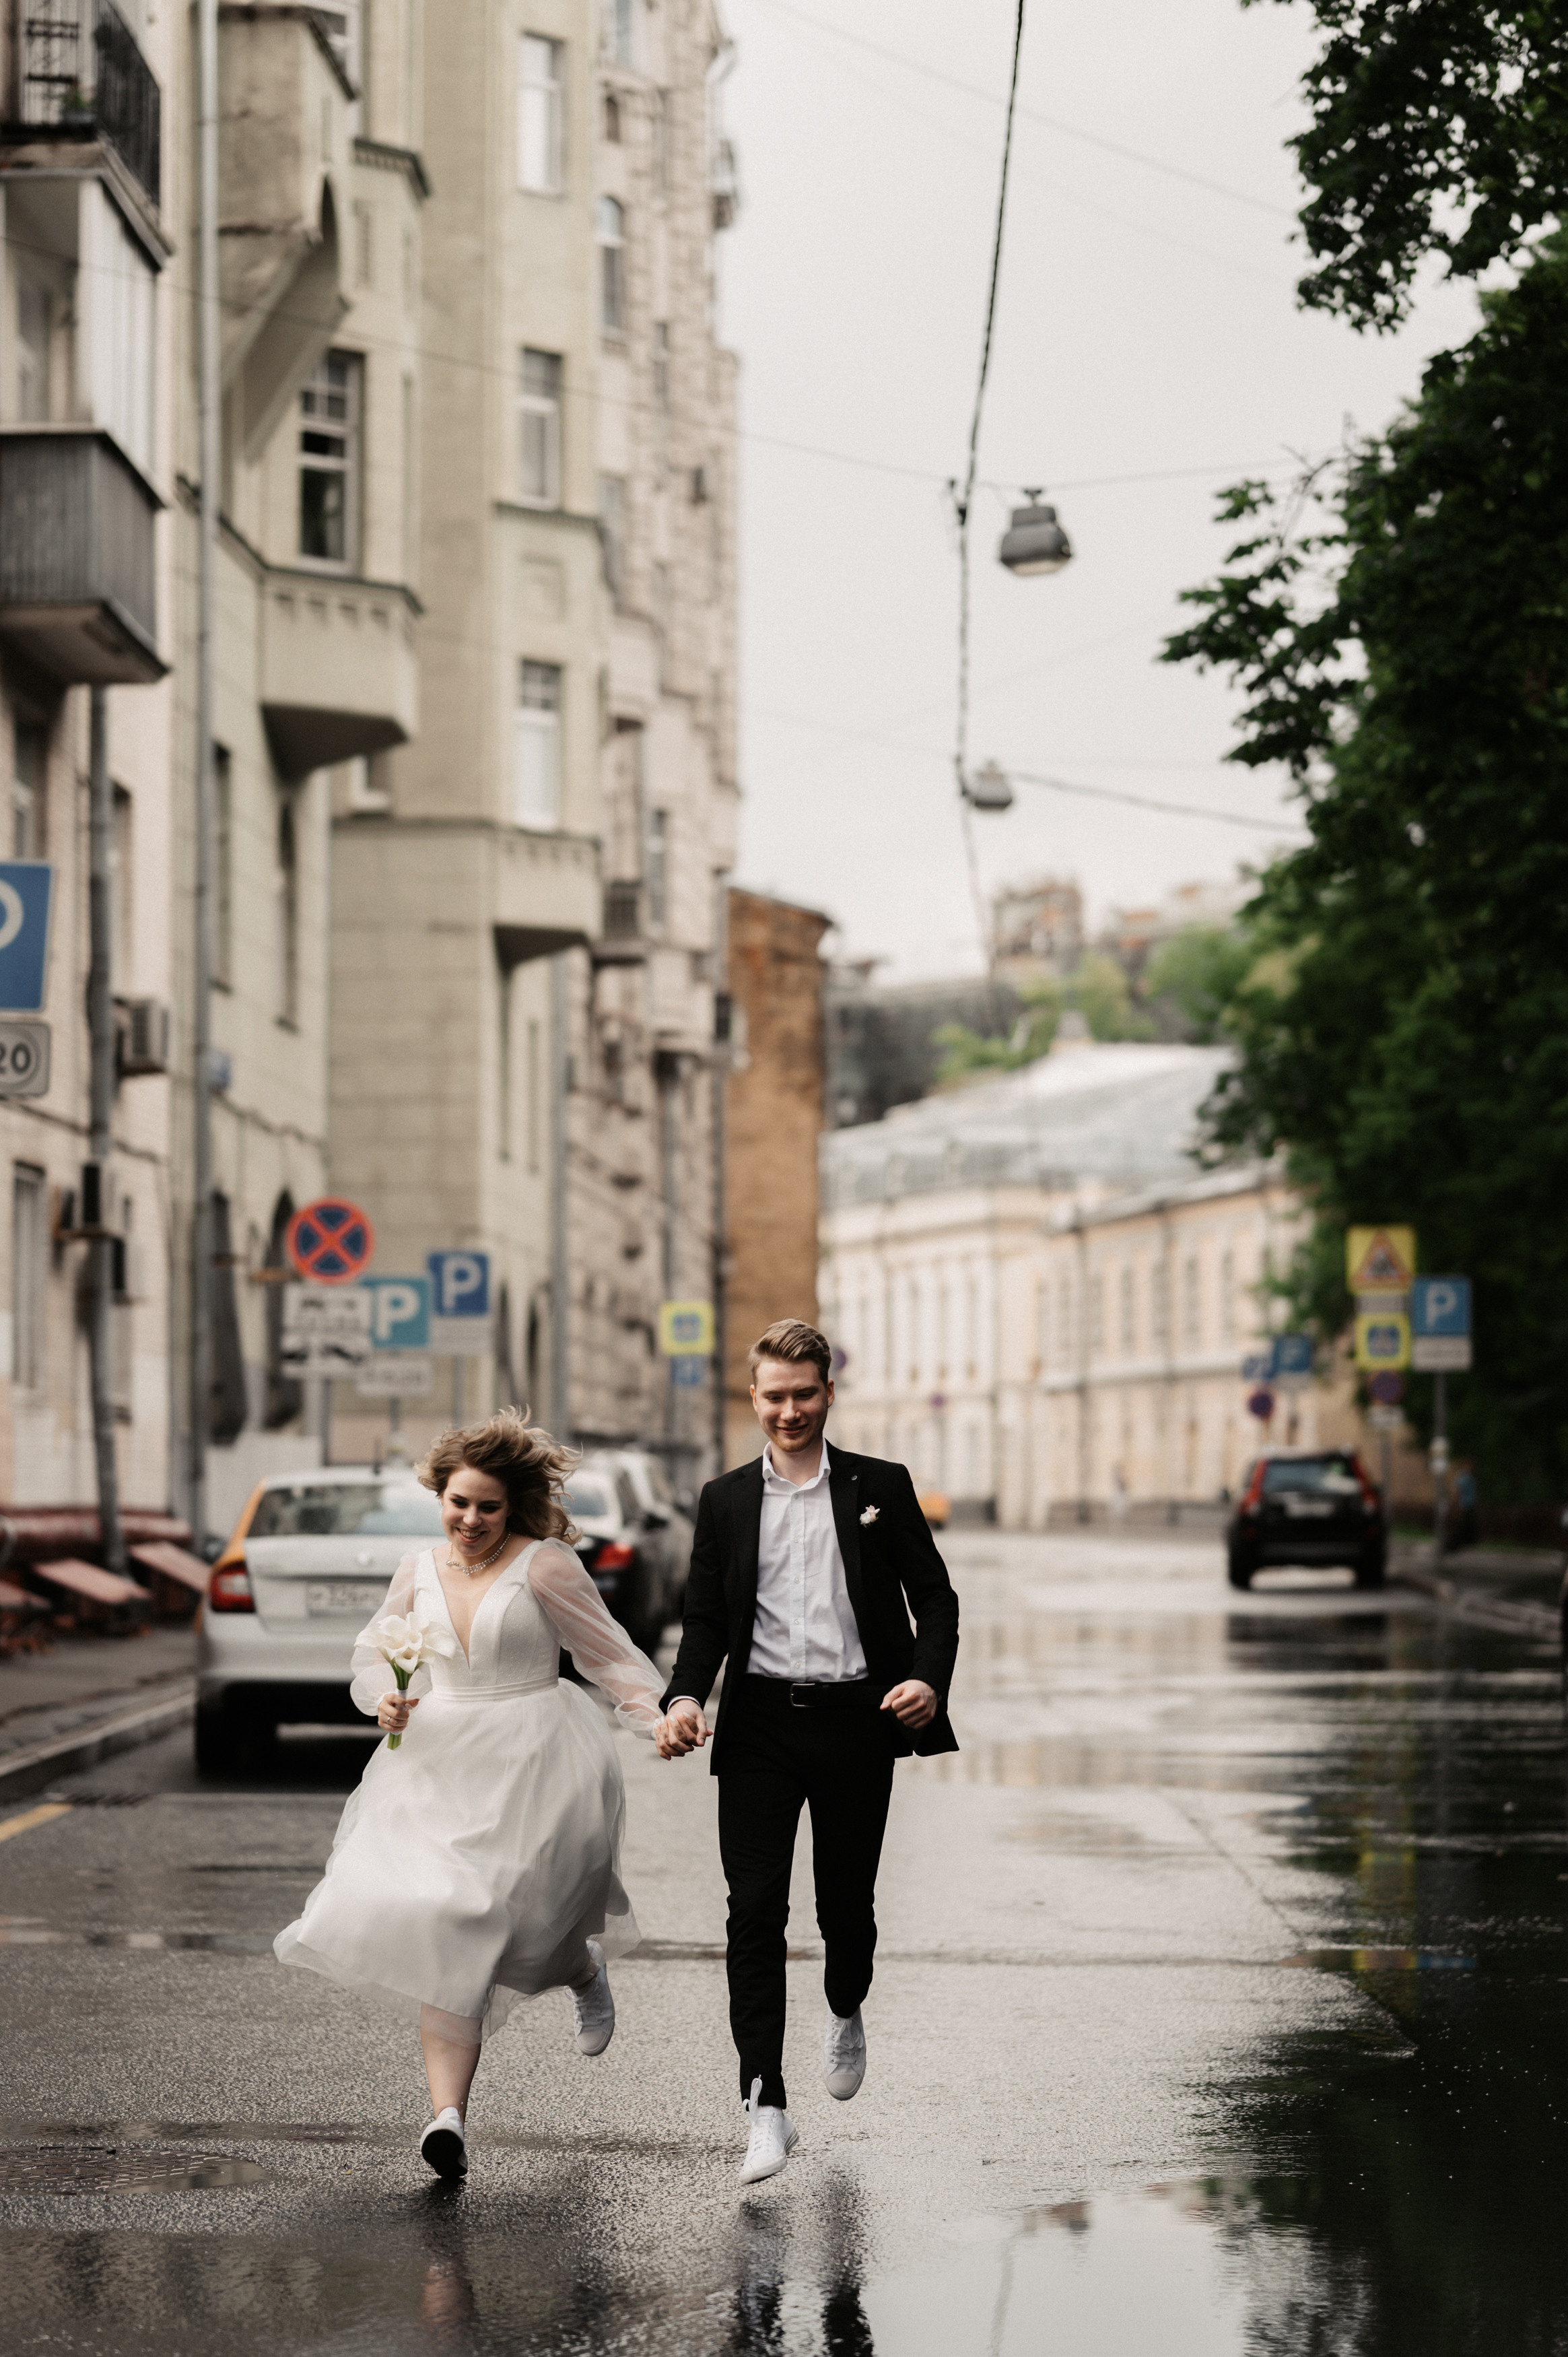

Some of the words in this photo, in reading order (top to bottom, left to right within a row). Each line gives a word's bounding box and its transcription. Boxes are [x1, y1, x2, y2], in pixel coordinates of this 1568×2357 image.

[442, 1257, 483, 1309] P
[1425, 1282, 1457, 1328] P
[375, 1284, 420, 1341] P
